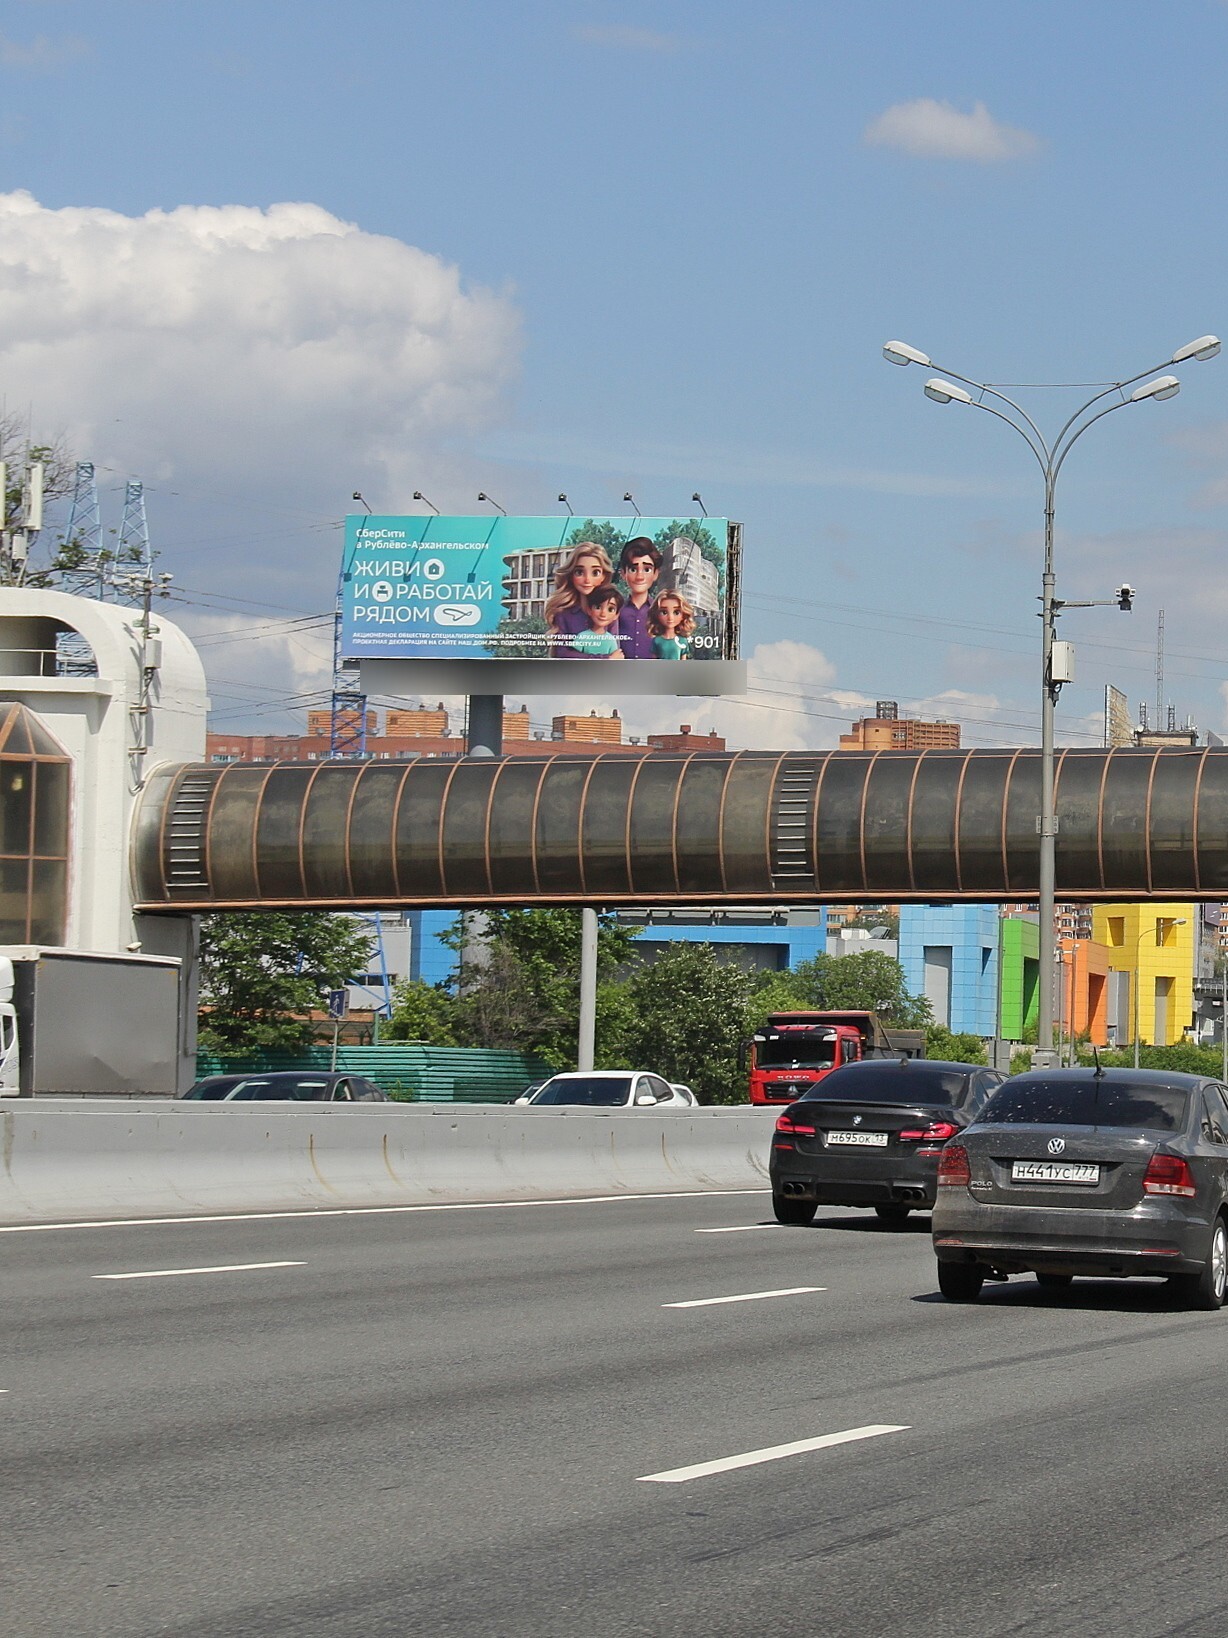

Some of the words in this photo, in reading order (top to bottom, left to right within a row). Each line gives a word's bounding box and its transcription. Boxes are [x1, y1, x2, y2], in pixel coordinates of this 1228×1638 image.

[356, 528, 405, 538] СберСити
[365, 540, 489, 551] Рублёво-Архангельском
[354, 560, 420, 577] ЖИВИ
[354, 583, 369, 599] И
[396, 580, 492, 600] РАБОТАЙ
[353, 606, 430, 624] РЯДОМ
[1075, 1164, 1096, 1177] 777
